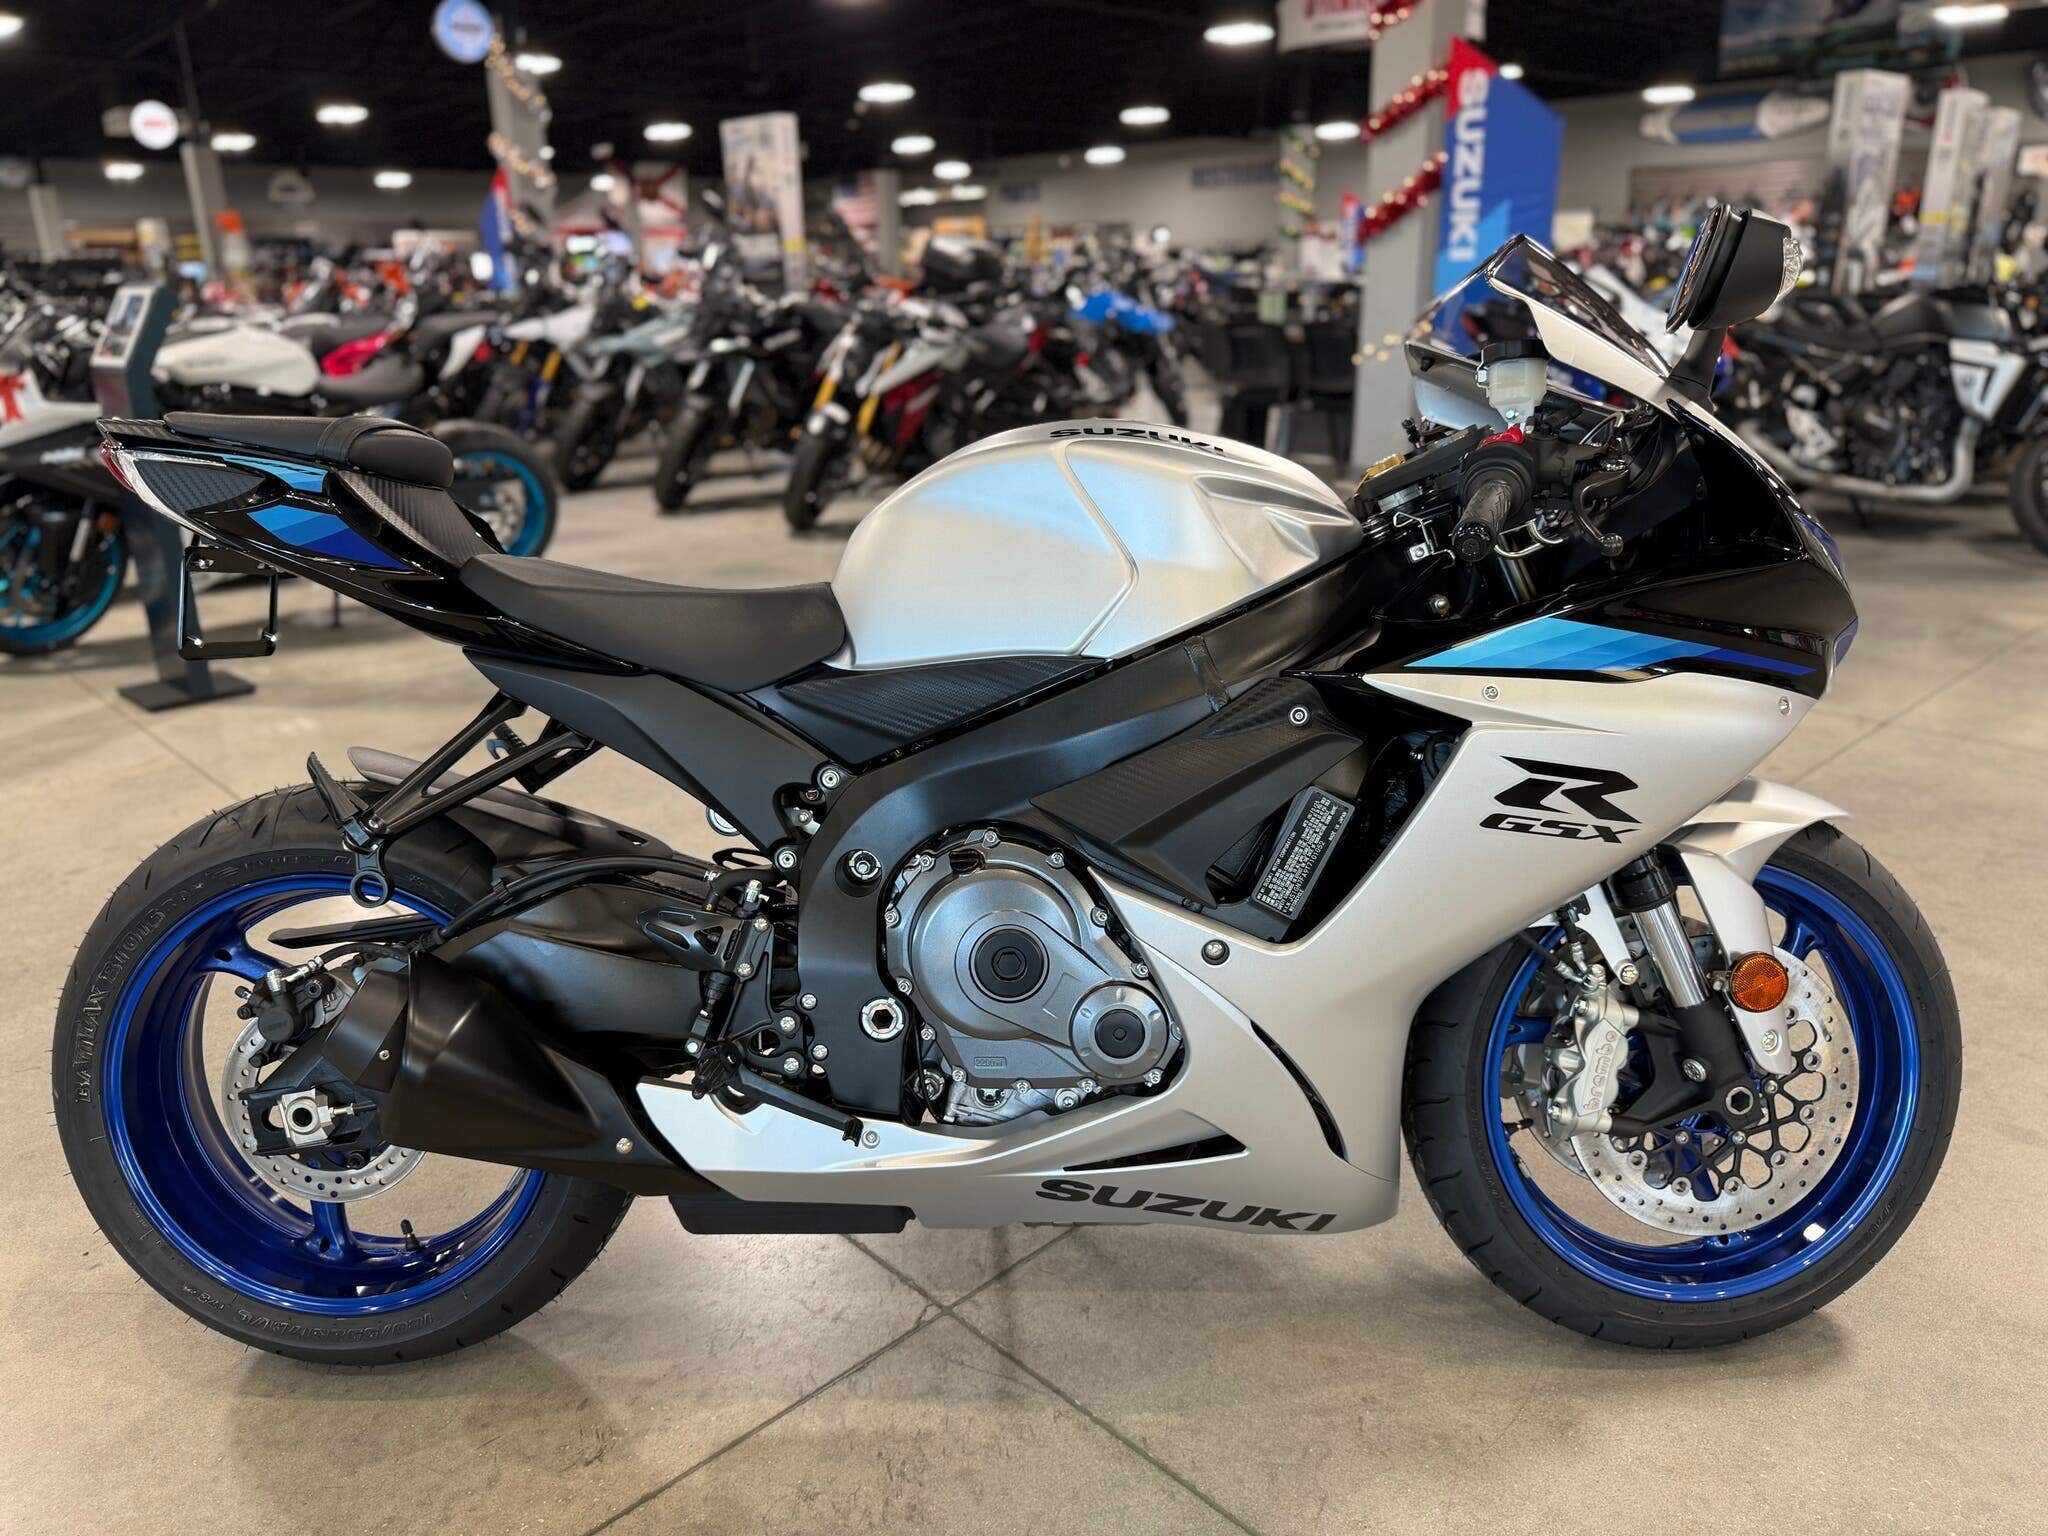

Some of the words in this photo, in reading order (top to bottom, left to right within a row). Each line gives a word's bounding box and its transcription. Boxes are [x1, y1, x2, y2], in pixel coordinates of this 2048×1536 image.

[1447, 68, 1490, 262] SUZUKI
[1049, 427, 1226, 457] SUZUKI
[1494, 755, 1643, 824] R
[1479, 813, 1641, 844] GSX
[1582, 1030, 1617, 1112] brembo
[1035, 1179, 1337, 1232] SUZUKI
